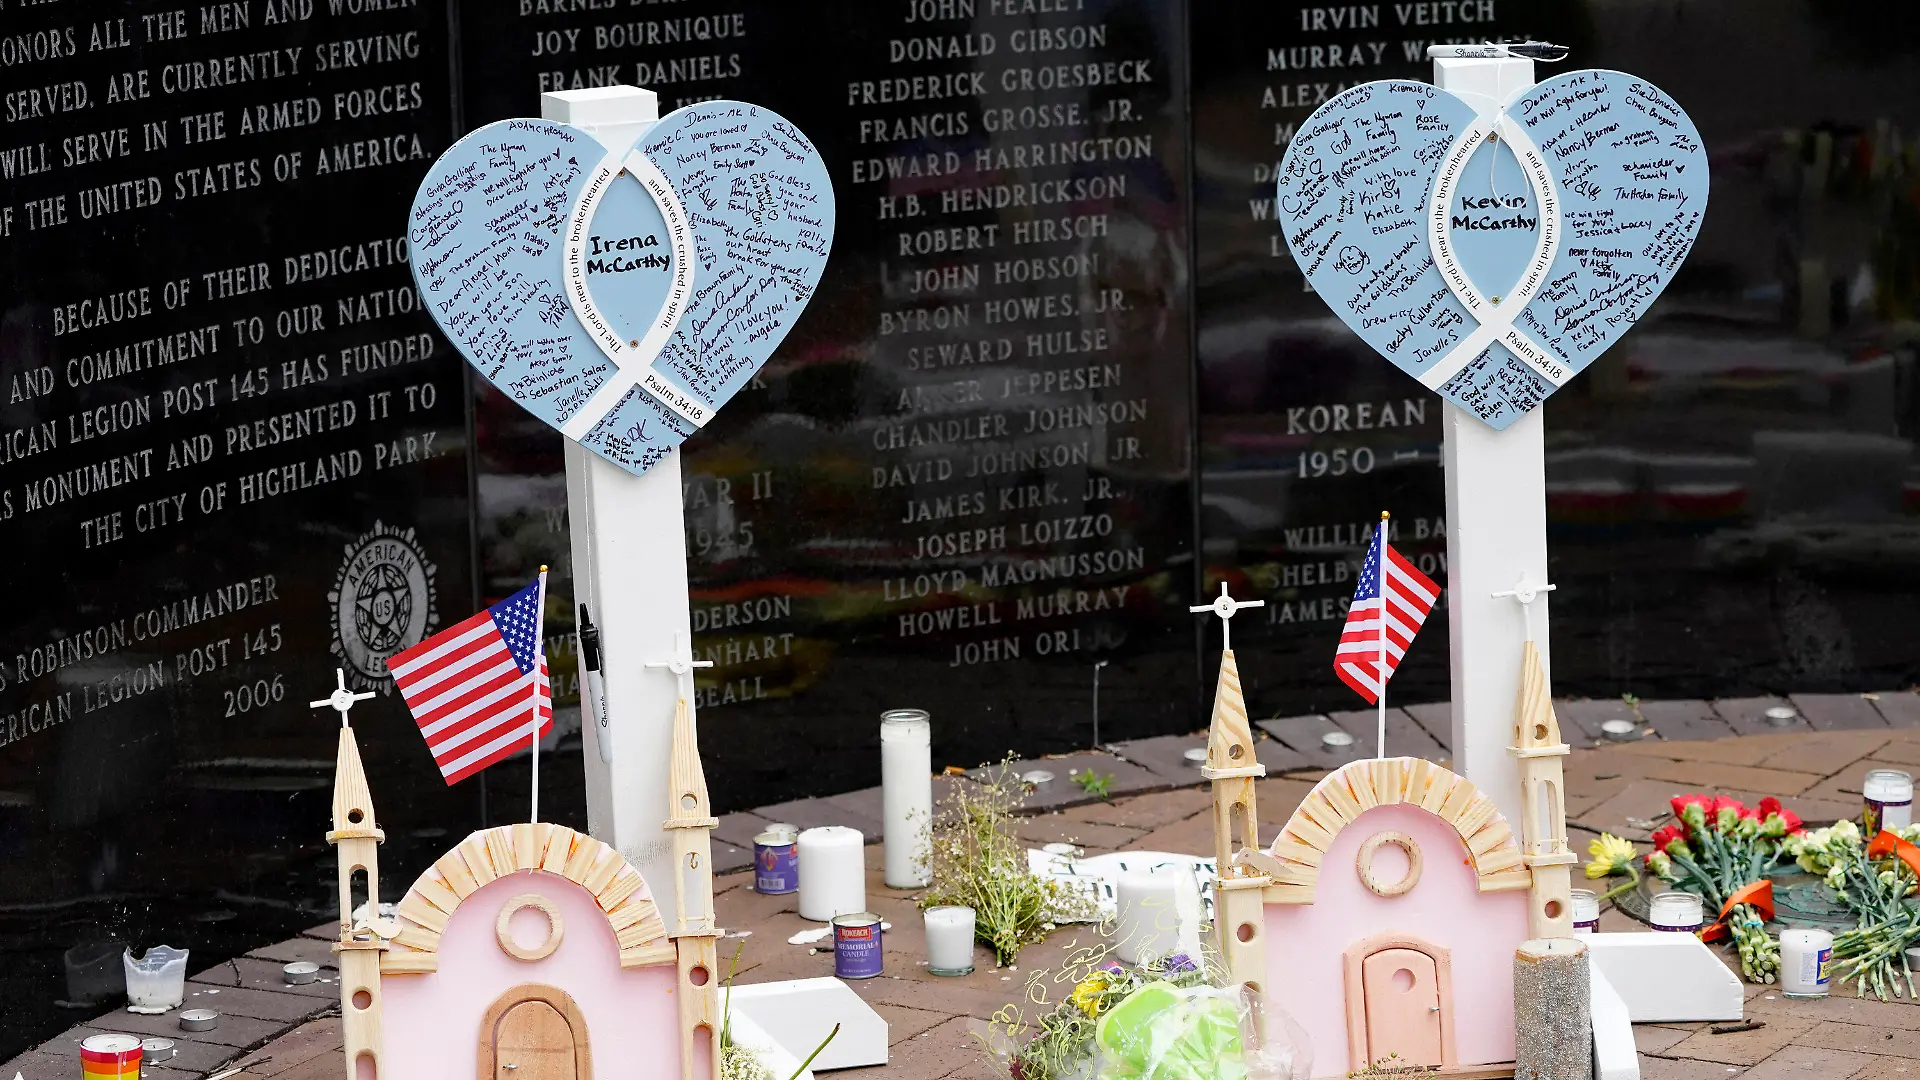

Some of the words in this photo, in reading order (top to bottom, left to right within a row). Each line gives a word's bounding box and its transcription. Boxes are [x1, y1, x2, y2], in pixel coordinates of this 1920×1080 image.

[905, 0, 976, 23] JOHN
[1301, 6, 1379, 32] IRVIN
[1395, 0, 1496, 27] VEITCH
[0, 26, 76, 67] ONORS
[89, 19, 131, 52] ALL
[142, 9, 187, 42] THE
[201, 0, 249, 35] MEN
[264, 0, 312, 26] AND
[532, 29, 580, 56] JOY
[596, 14, 745, 50] BOURNIQUE
[890, 34, 996, 63] DONALD
[1011, 25, 1107, 53] GIBSON
[107, 69, 151, 105] ARE
[162, 46, 302, 95] CURRENTLY
[316, 30, 420, 72] SERVING
[538, 65, 623, 93] FRANK
[637, 54, 741, 85] DANIELS
[1267, 41, 1387, 71] MURRAY
[849, 72, 986, 106] FREDERICK
[1002, 59, 1152, 92] GROESBECK
[0, 142, 51, 180] WILL
[62, 128, 131, 168] SERVE
[144, 122, 168, 152] IN
[180, 110, 226, 147] THE
[239, 97, 321, 136] ARMED
[334, 82, 422, 121] FORCES
[860, 112, 969, 143] FRANCIS
[1105, 99, 1143, 123] JR.
[853, 152, 960, 183] EDWARD
[975, 135, 1152, 172] HARRINGTON
[1437, 129, 1481, 199] brokenhearted
[1526, 150, 1542, 169] and
[25, 194, 68, 231] THE
[79, 177, 162, 220] UNITED
[174, 157, 262, 200] STATES
[274, 151, 302, 182] OF
[315, 134, 432, 176] AMERICA.
[648, 179, 664, 197] and
[880, 194, 927, 219] H.B.
[942, 175, 1126, 212] HENDRICKSON
[1462, 194, 1527, 211] Kevin
[1538, 169, 1551, 196] saves
[570, 168, 610, 242] brokenhearted
[662, 197, 678, 223] saves
[1435, 203, 1444, 220] the
[1452, 214, 1536, 232] McCarthy
[1545, 198, 1554, 215] the
[590, 235, 658, 256] Irena
[674, 224, 683, 241] the
[899, 224, 999, 257] ROBERT
[1014, 215, 1109, 245] HIRSCH
[1541, 217, 1554, 260] crushed
[569, 248, 578, 265] the
[586, 253, 670, 275] McCarthy
[677, 245, 687, 287] crushed
[911, 264, 979, 294] JOHN
[995, 253, 1099, 285] HOBSON
[53, 287, 152, 337] BECAUSE
[163, 279, 191, 310] OF
[202, 262, 272, 301] THEIR
[284, 236, 409, 285] DEDICATIO
[880, 304, 970, 336] BYRON
[10, 365, 55, 404] AND
[67, 324, 220, 388] COMMITMENT
[234, 316, 264, 347] TO
[277, 304, 324, 339] OUR
[908, 339, 1013, 371] SEWARD
[1028, 329, 1109, 357] HULSE
[1506, 331, 1533, 358] Psalm
[1534, 355, 1562, 379] 34:18
[69, 398, 151, 444] LEGION
[163, 379, 218, 419] POST
[230, 367, 270, 402] 145
[281, 354, 329, 389] HAS
[341, 333, 434, 377] FUNDED
[645, 375, 674, 400] Psalm
[674, 396, 703, 420] 34:18
[873, 415, 1009, 451] CHANDLER
[1025, 399, 1148, 434] JOHNSON
[1287, 399, 1427, 435] KOREAN
[25, 448, 153, 513] MONUMENT
[167, 433, 213, 472] AND
[226, 400, 357, 456] PRESENTED
[369, 393, 391, 421] IT
[404, 382, 436, 414] TO
[1299, 447, 1375, 479] 1950
[80, 511, 124, 549] THE
[135, 493, 187, 533] CITY
[200, 486, 227, 515] OF
[239, 449, 362, 504] HIGHLAND
[375, 432, 446, 471] PARK.
[873, 459, 953, 489] DAVID
[902, 492, 986, 524] JAMES
[912, 527, 1007, 560] JOSEPH
[1020, 513, 1113, 546] LOIZZO
[348, 543, 415, 588] AMERICAN
[883, 569, 966, 603] LLOYD
[981, 548, 1145, 588] MAGNUSSON
[376, 602, 391, 617] US
[900, 602, 1002, 638] HOWELL
[1017, 585, 1130, 622] MURRAY
[1269, 599, 1348, 625] JAMES
[83, 660, 164, 715] LEGION
[176, 638, 230, 681] POST
[243, 623, 283, 661] 145
[950, 636, 1021, 668] JOHN
[1036, 629, 1081, 656] ORI
[223, 673, 284, 719] 2006
[837, 942, 875, 950] MEMORIAL
[842, 950, 870, 958] CANDLE
